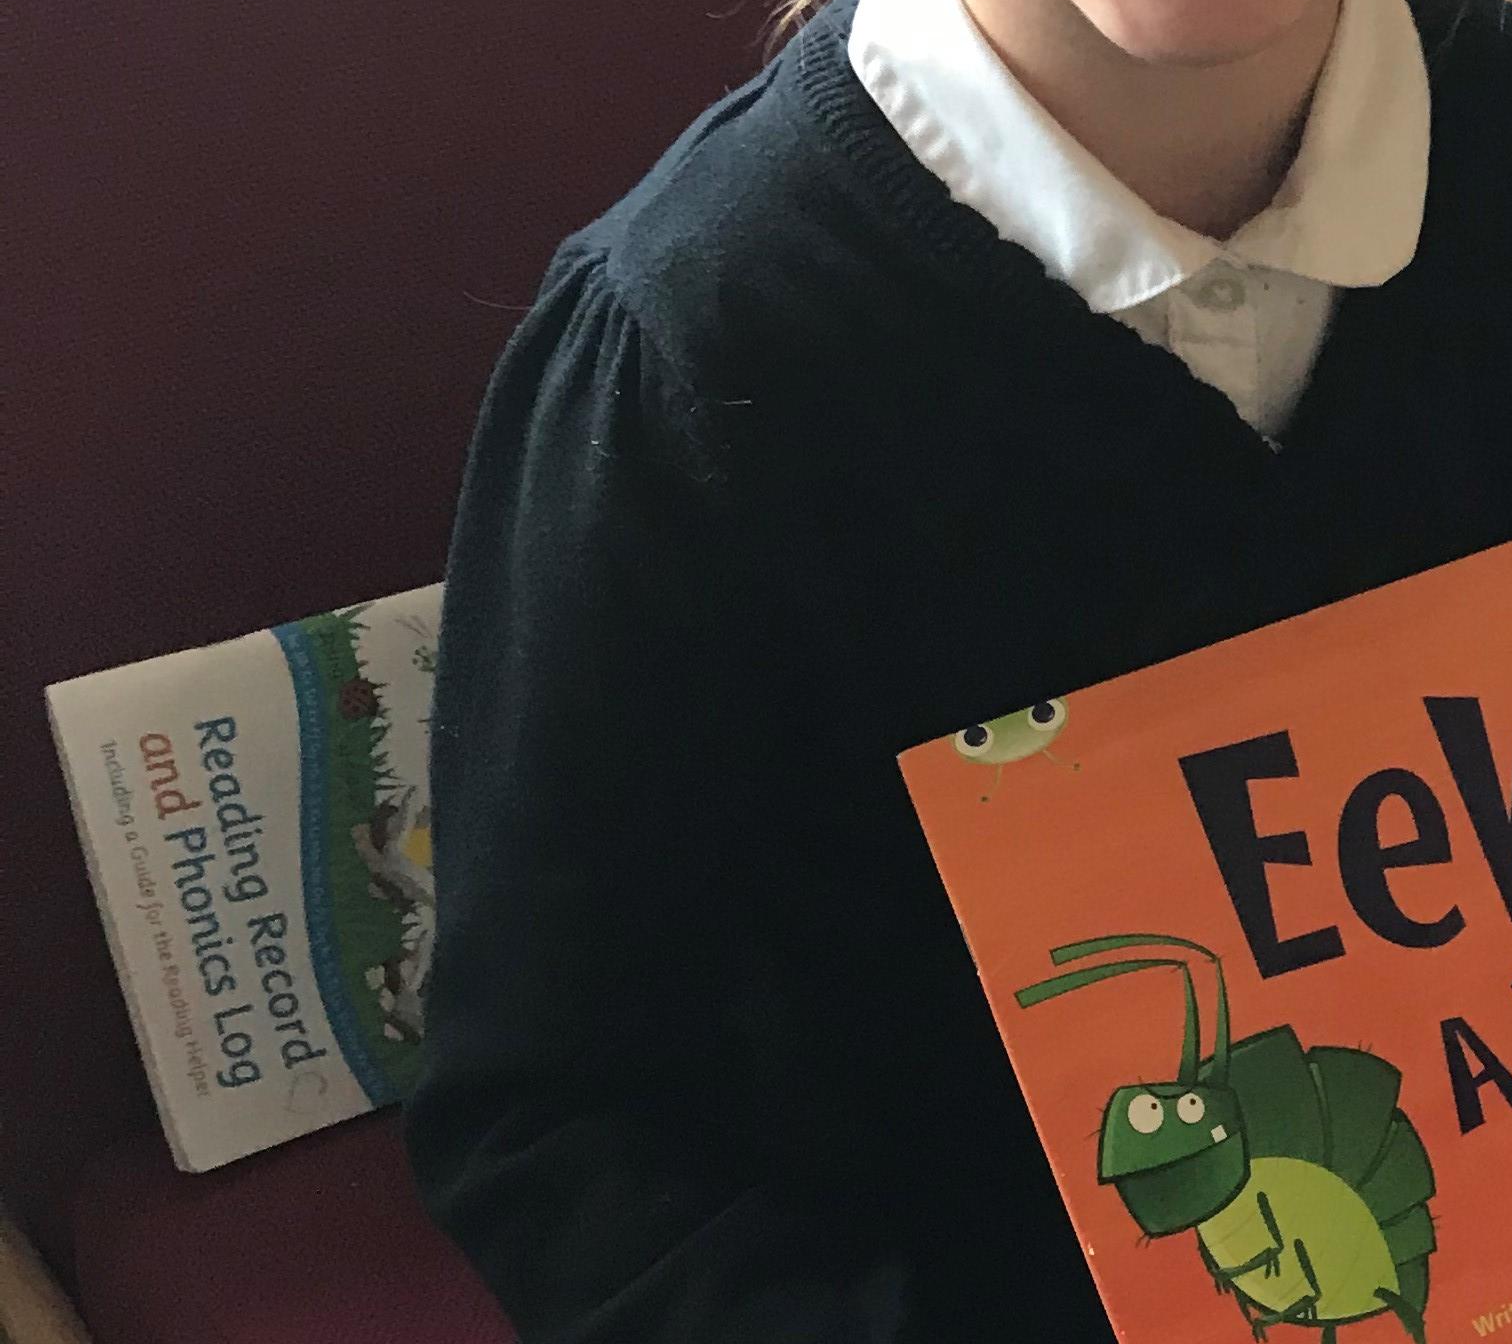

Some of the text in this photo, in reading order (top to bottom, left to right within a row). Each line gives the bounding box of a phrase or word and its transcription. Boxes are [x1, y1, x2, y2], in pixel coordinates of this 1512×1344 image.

[101, 739, 209, 1097] Including a Guide for the Reading Helper
[139, 733, 264, 1088] and Phonics Log
[193, 716, 269, 903] Reading
[247, 912, 328, 1069] Record
